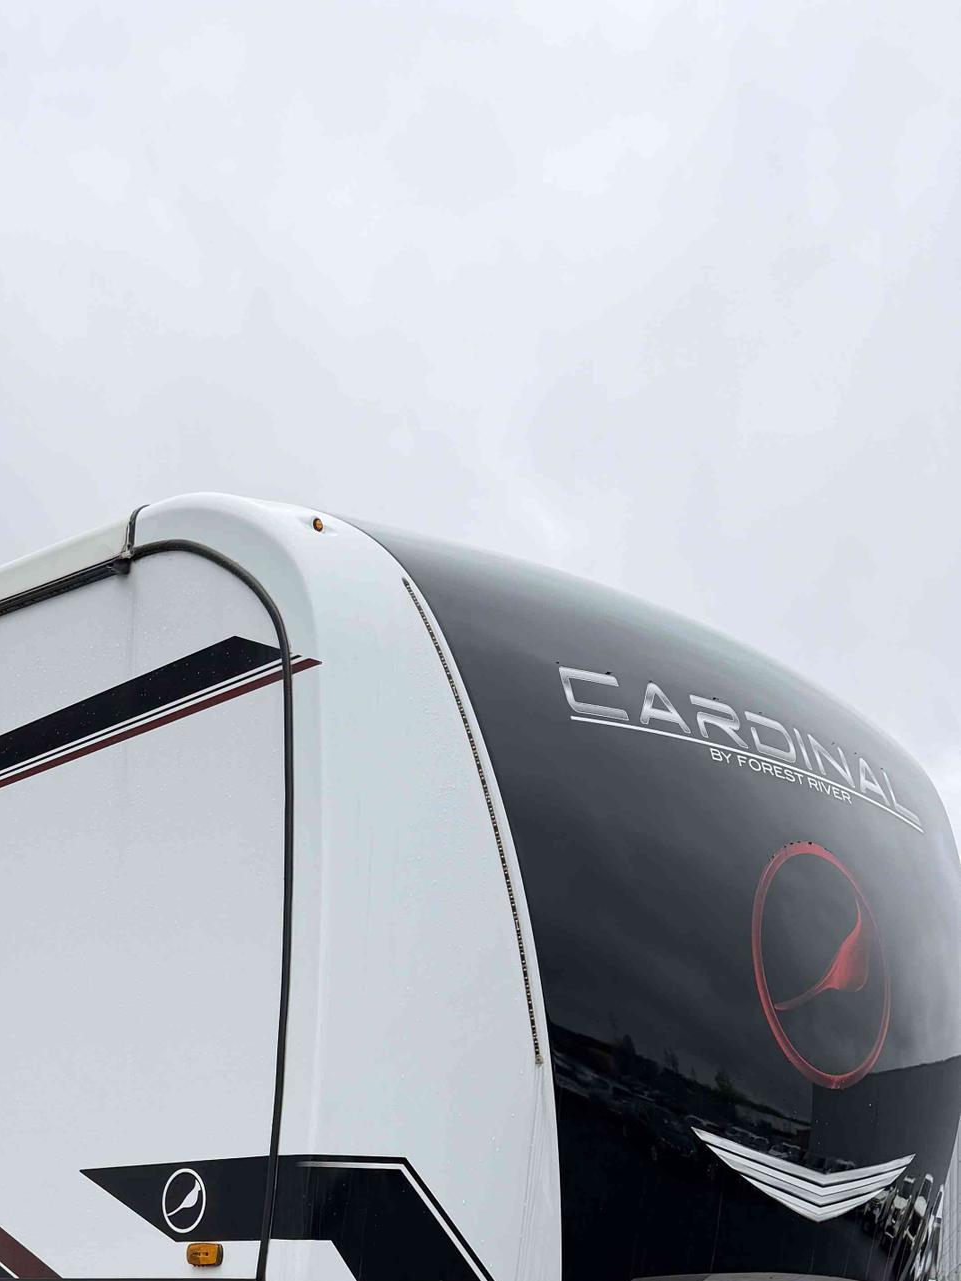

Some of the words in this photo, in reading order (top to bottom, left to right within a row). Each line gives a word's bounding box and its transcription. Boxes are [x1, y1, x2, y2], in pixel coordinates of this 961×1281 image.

[558, 665, 921, 825] CARDINAL
[709, 747, 731, 764] BY
[737, 754, 804, 784] FOREST
[808, 776, 853, 805] RIVER
